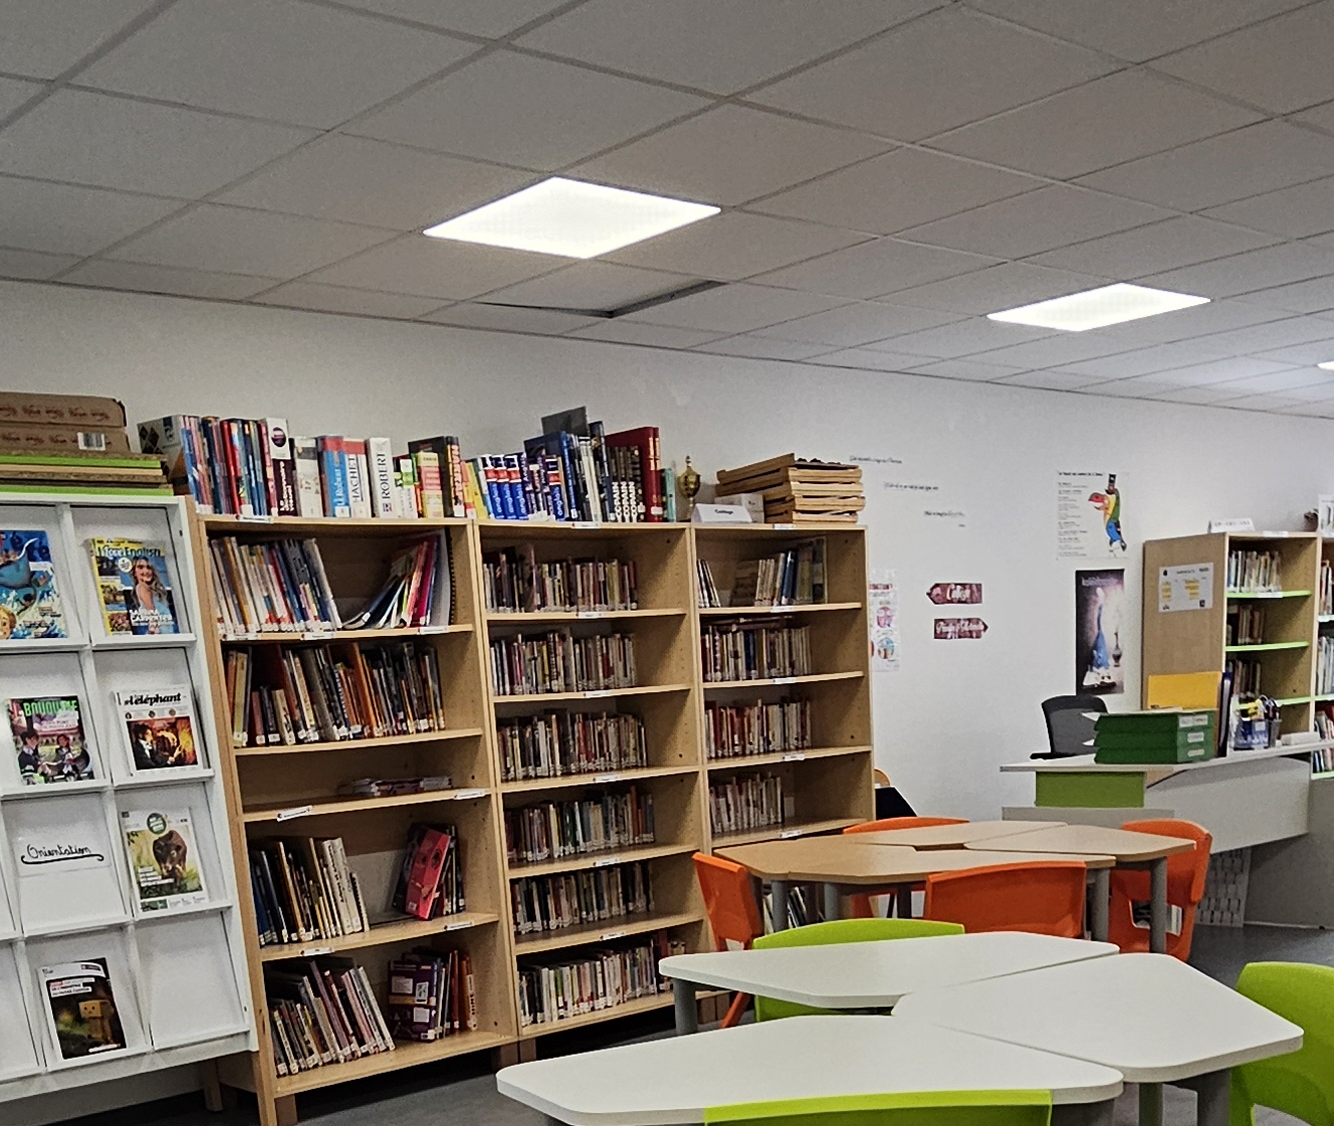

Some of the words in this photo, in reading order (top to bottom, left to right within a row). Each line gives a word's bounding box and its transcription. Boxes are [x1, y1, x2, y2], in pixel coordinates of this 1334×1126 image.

[348, 457, 360, 502] HACHET
[376, 454, 390, 499] ROBERT
[27, 844, 92, 858] Orientation
